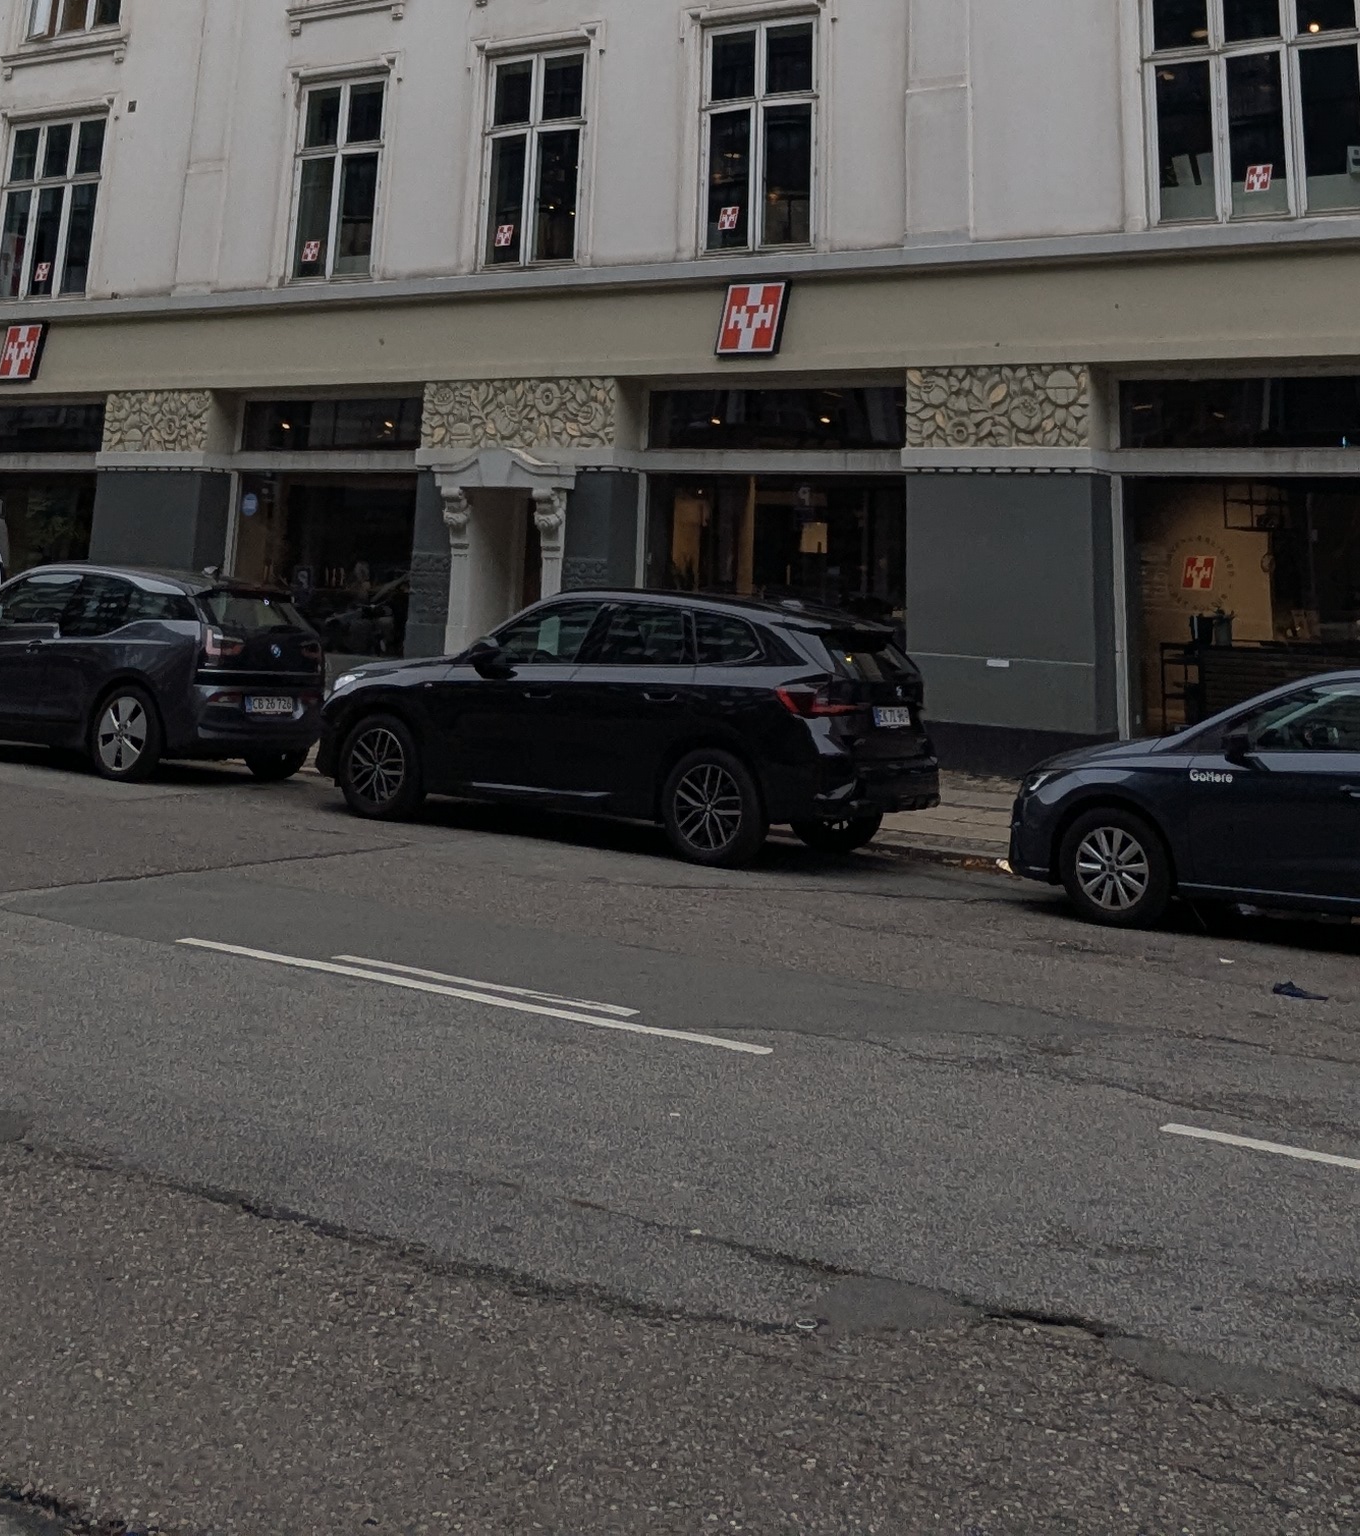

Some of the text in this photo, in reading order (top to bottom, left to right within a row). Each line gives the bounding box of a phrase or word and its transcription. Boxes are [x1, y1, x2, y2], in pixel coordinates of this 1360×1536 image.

[727, 304, 775, 330] HTH
[5, 340, 35, 361] HTH
[1189, 769, 1233, 783] GoMore
